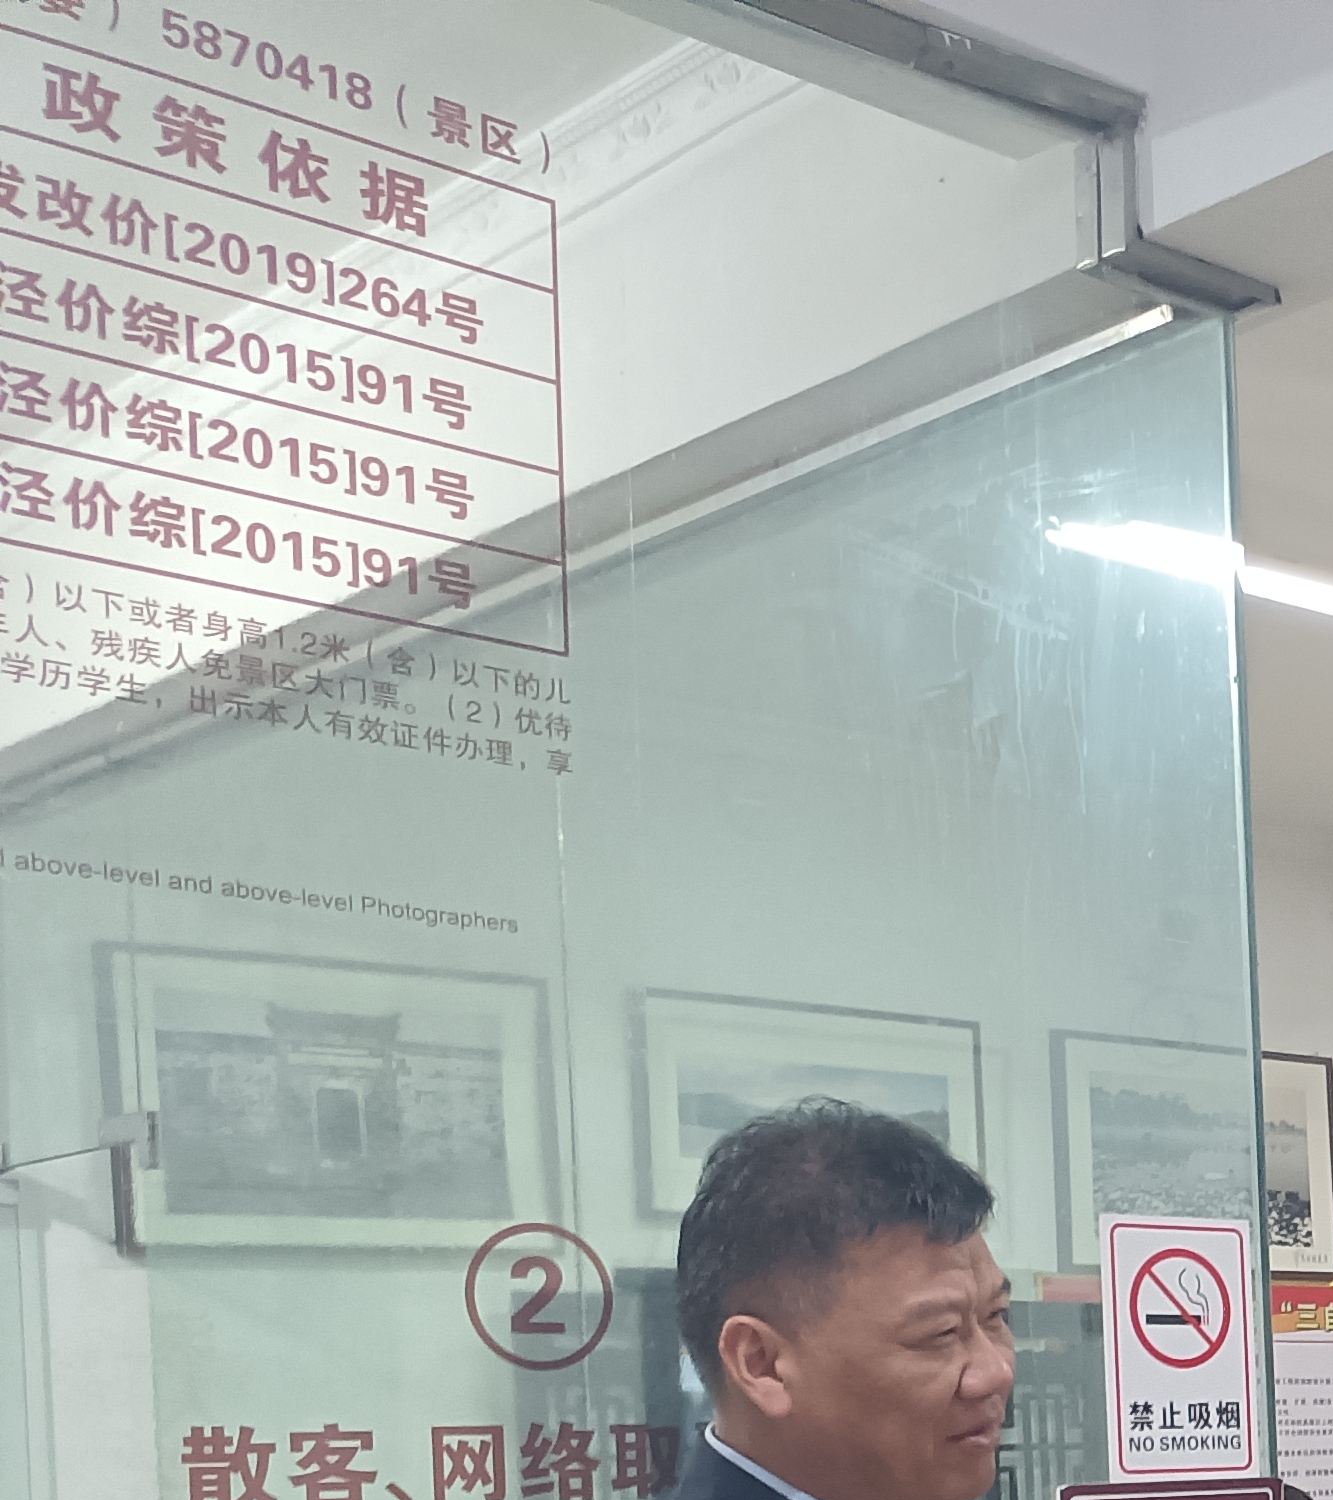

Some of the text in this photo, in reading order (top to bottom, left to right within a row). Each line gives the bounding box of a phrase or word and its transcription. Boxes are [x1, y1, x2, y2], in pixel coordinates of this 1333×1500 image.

[42, 62, 429, 237] 政策依据
[0, 261, 473, 430] 泾价综[2015]91号
[0, 361, 475, 520] 泾价综[2015]91号
[0, 461, 478, 610] 泾价综[2015]91号
[0, 573, 571, 704] ）以下或者身高1.2米（含）以下的儿
[14, 852, 160, 887] above-level
[168, 875, 213, 895] and
[220, 879, 353, 913] above-level
[361, 895, 519, 934] Photographers
[1129, 1400, 1241, 1431] 禁止吸烟
[1129, 1435, 1242, 1452] NO SMOKING
